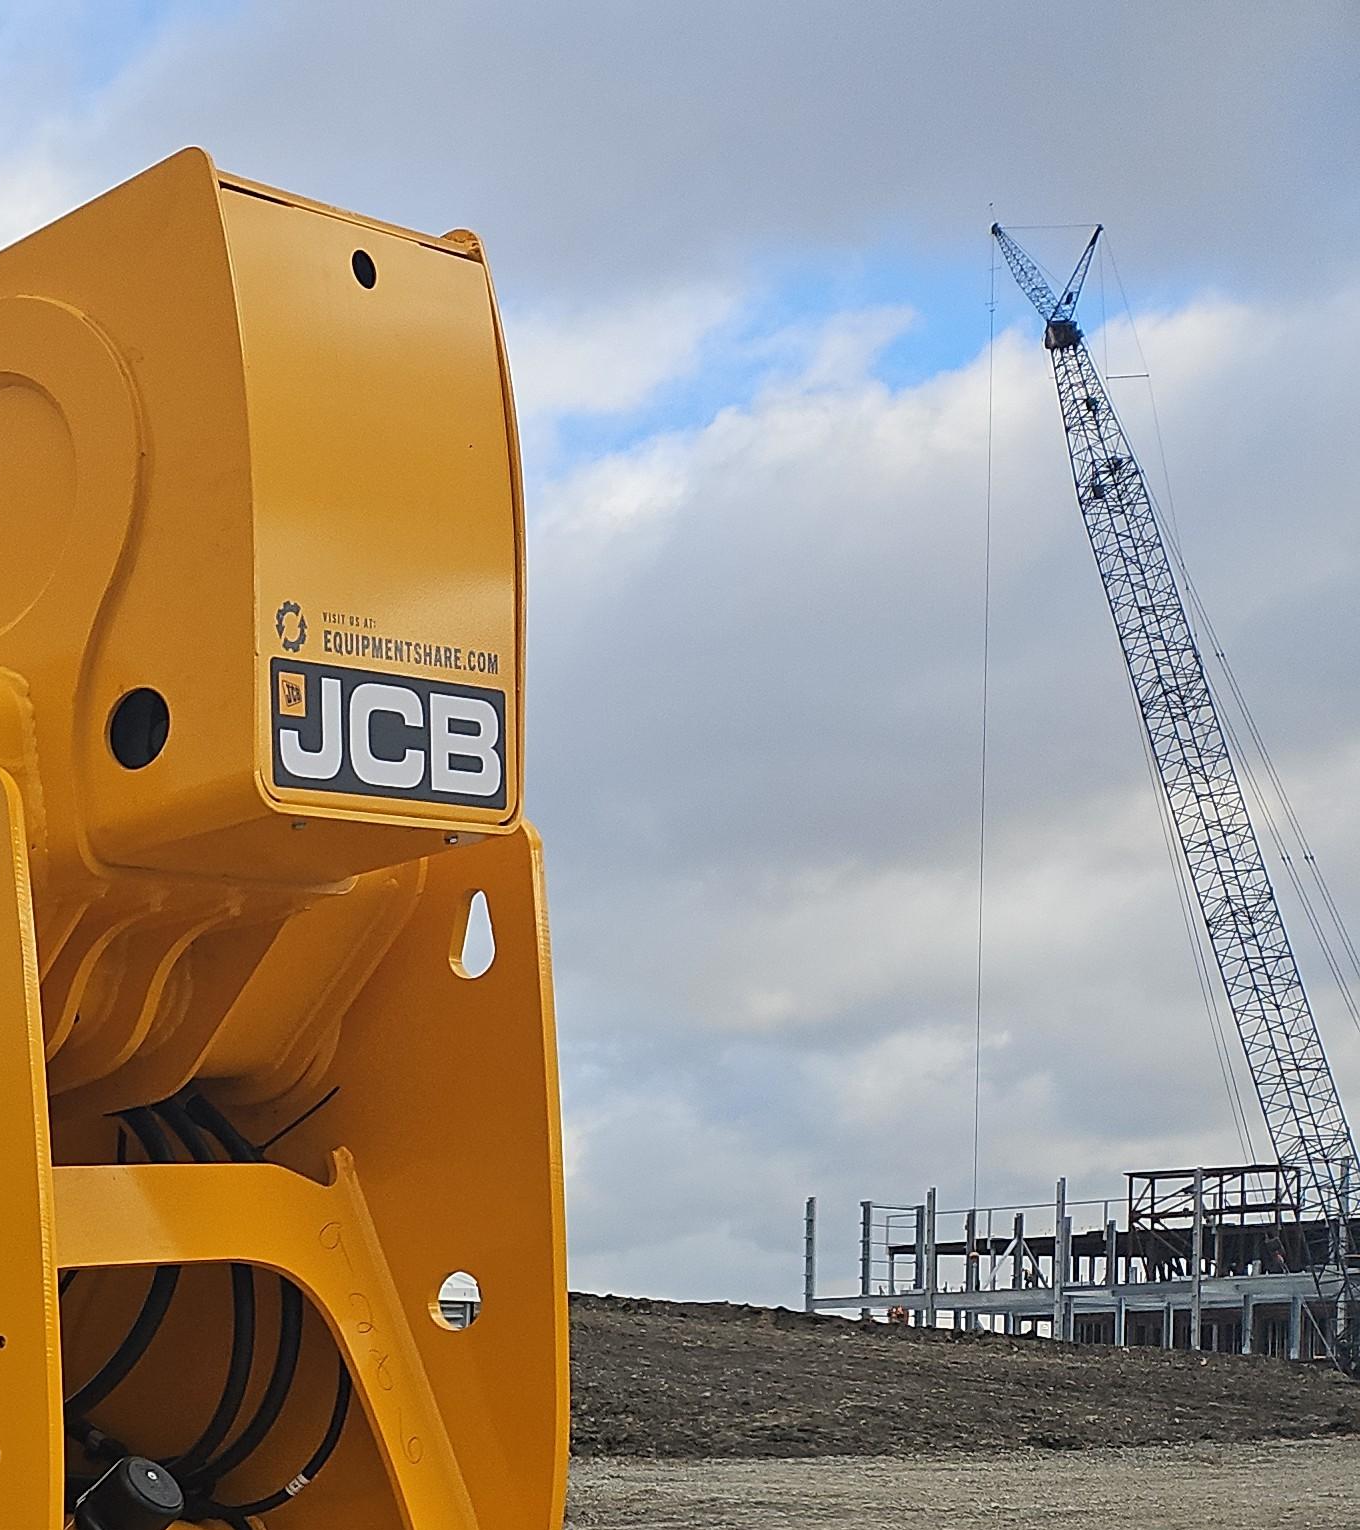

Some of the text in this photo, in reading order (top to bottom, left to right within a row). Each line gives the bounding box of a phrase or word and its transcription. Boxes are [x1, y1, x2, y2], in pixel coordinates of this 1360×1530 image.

[322, 611, 346, 625] VISIT
[349, 615, 361, 627] US
[323, 629, 499, 675] EQUIPMENTSHARE.COM
[283, 681, 302, 705] JCB
[280, 677, 502, 797] JCB
